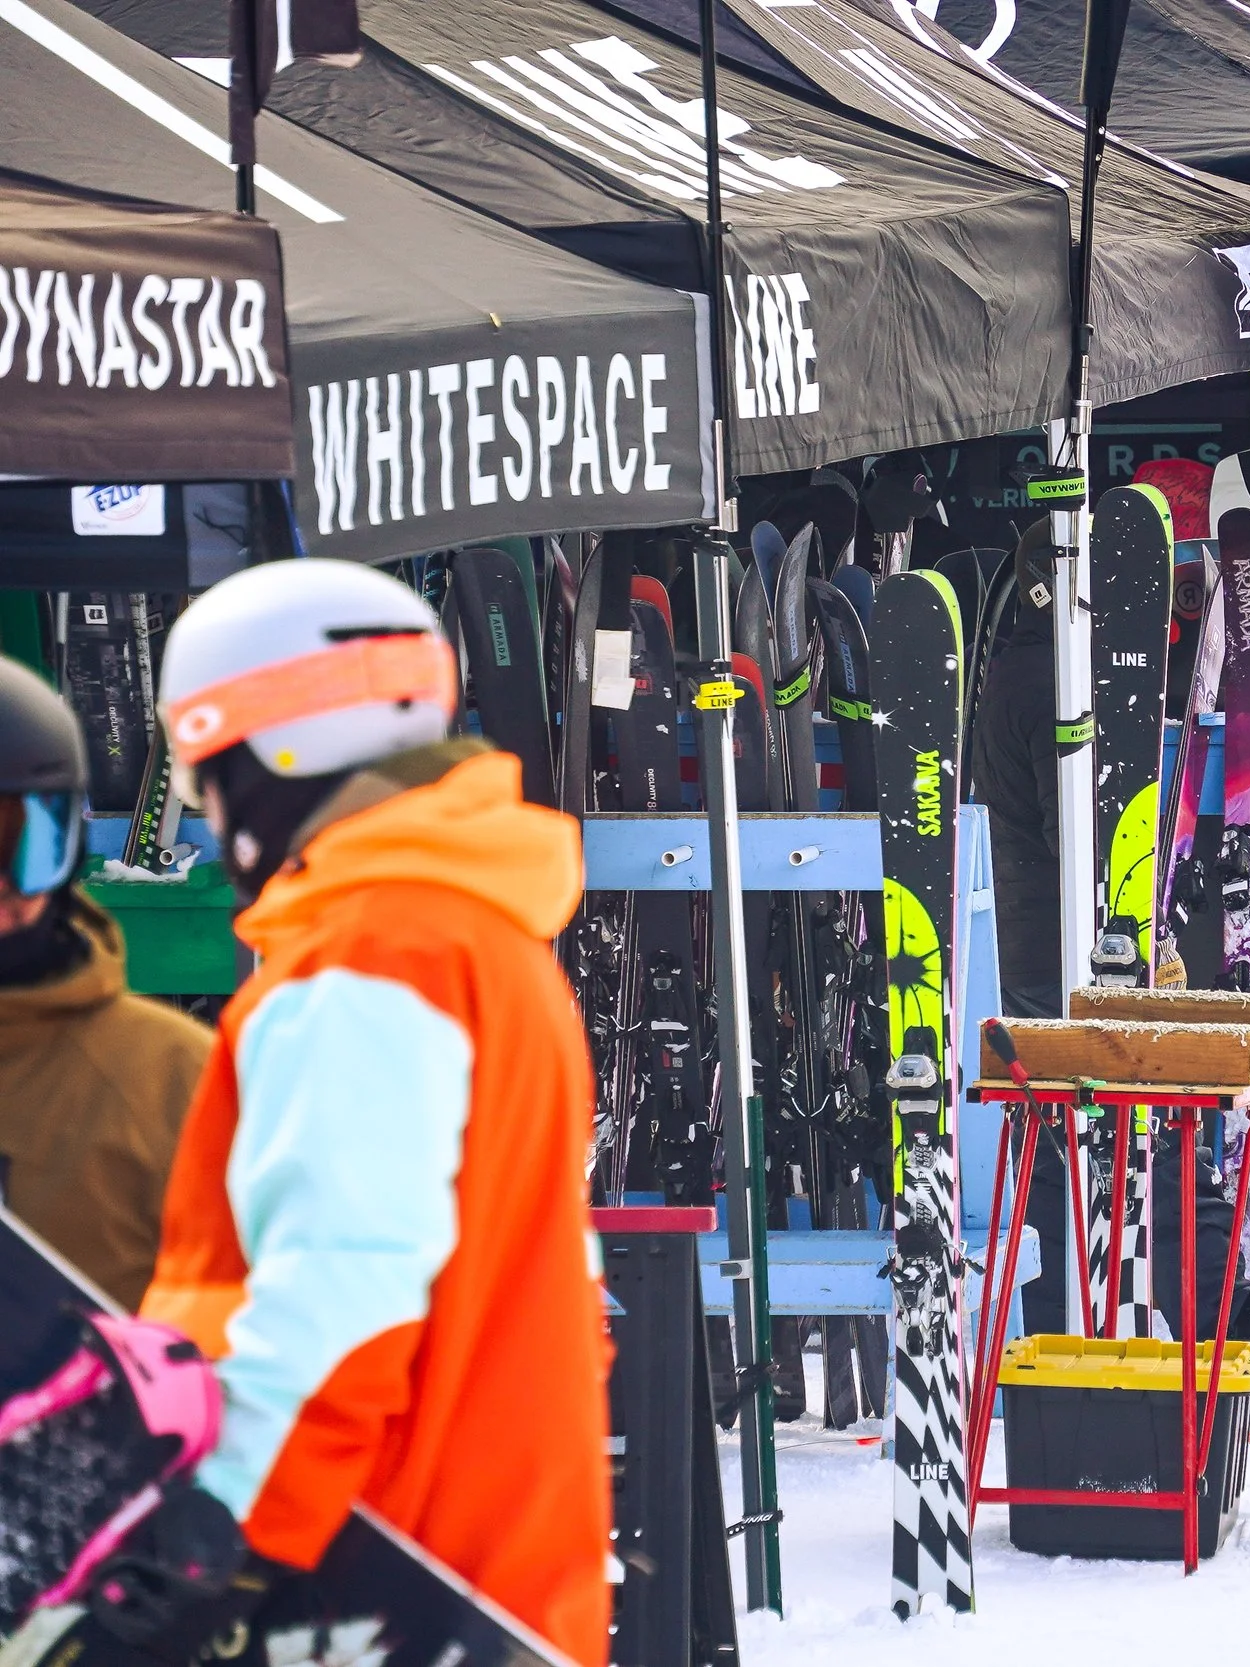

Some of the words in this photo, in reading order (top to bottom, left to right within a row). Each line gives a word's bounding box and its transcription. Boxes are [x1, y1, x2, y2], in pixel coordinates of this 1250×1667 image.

[726, 272, 820, 420] LINE
[308, 353, 671, 535] WHITESPACE
[492, 618, 506, 661] ARMADA
[1112, 652, 1147, 668] LINE
[711, 697, 733, 707] LINE
[109, 706, 120, 743] DECLIVITY
[107, 745, 121, 756] X
[648, 768, 656, 800] DECLIVITY
[916, 750, 942, 837] SAKANA
[910, 1464, 949, 1480] LINE
